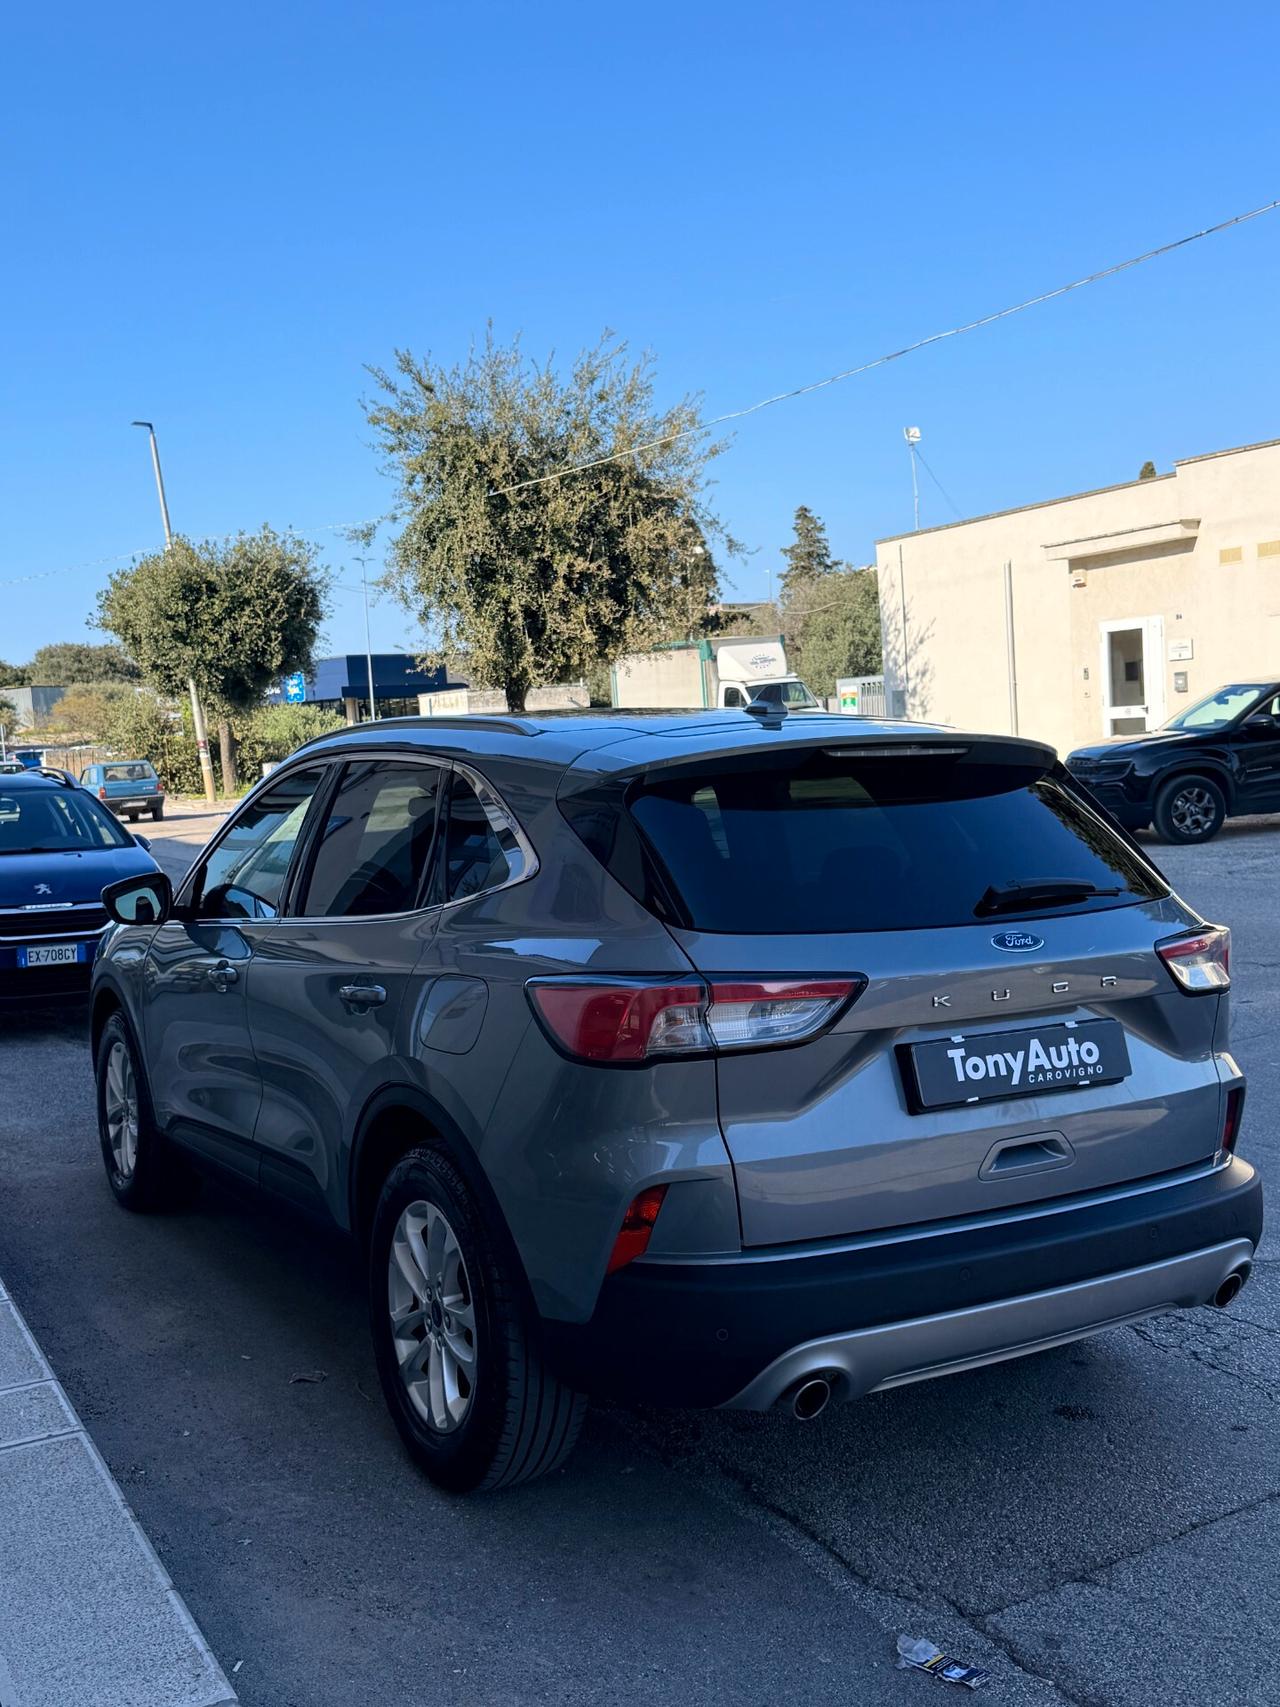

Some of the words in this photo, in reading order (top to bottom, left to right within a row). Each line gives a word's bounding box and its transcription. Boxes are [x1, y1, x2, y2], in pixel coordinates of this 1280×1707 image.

[1005, 933, 1034, 947] Ford
[932, 975, 1117, 1007] KUGA
[1028, 1065, 1103, 1084] CAROVIGNO
